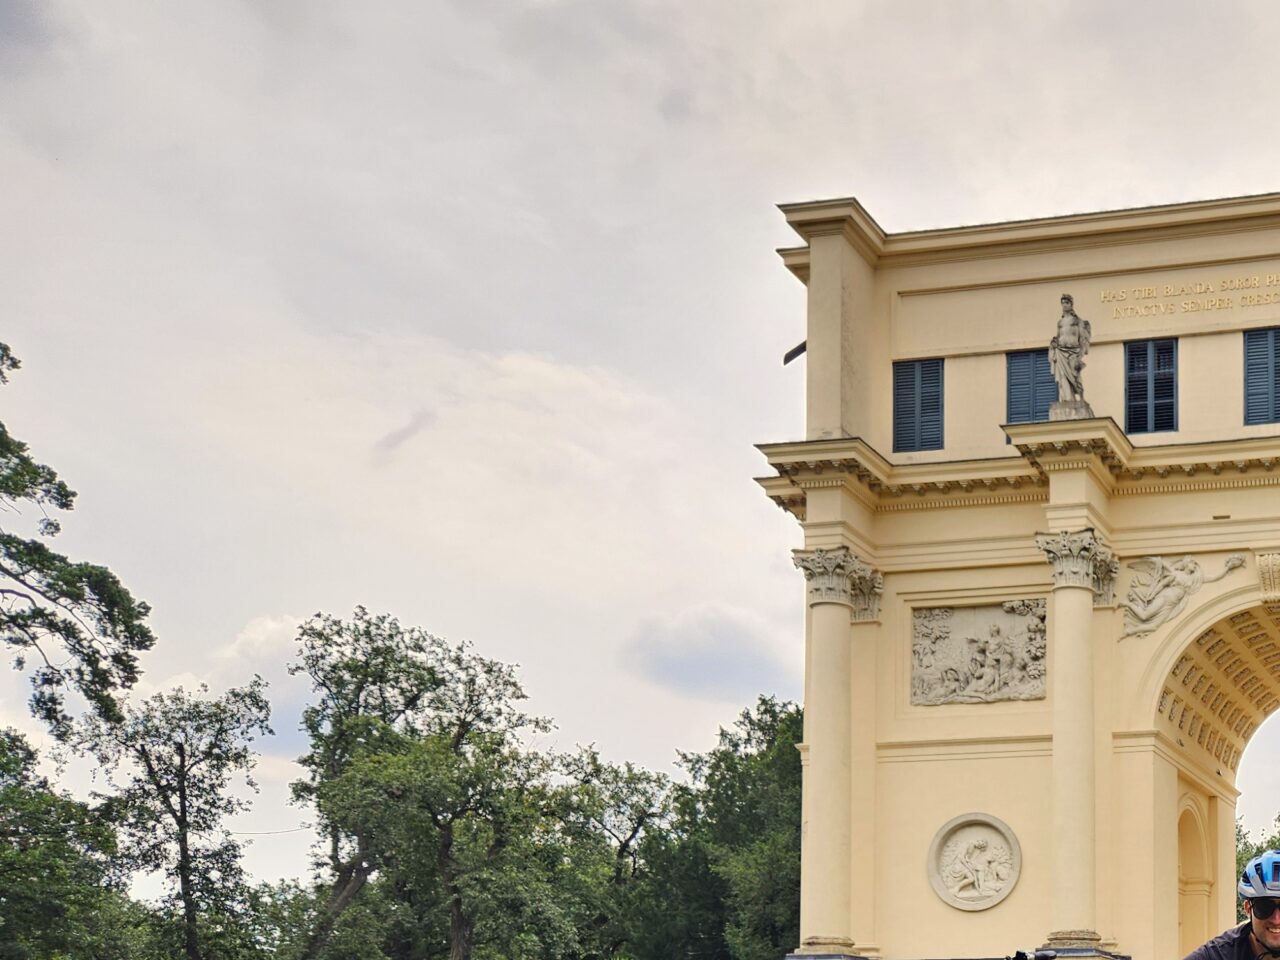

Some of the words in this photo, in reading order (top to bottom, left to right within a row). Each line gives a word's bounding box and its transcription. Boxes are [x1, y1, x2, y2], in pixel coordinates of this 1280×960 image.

[1101, 289, 1127, 303] HAS
[1133, 286, 1157, 299] TIBI
[1163, 282, 1214, 297] BLANDA
[1220, 276, 1259, 291] SOROR
[1113, 303, 1175, 319] INTACTVS
[1181, 297, 1232, 313] SEMPER
